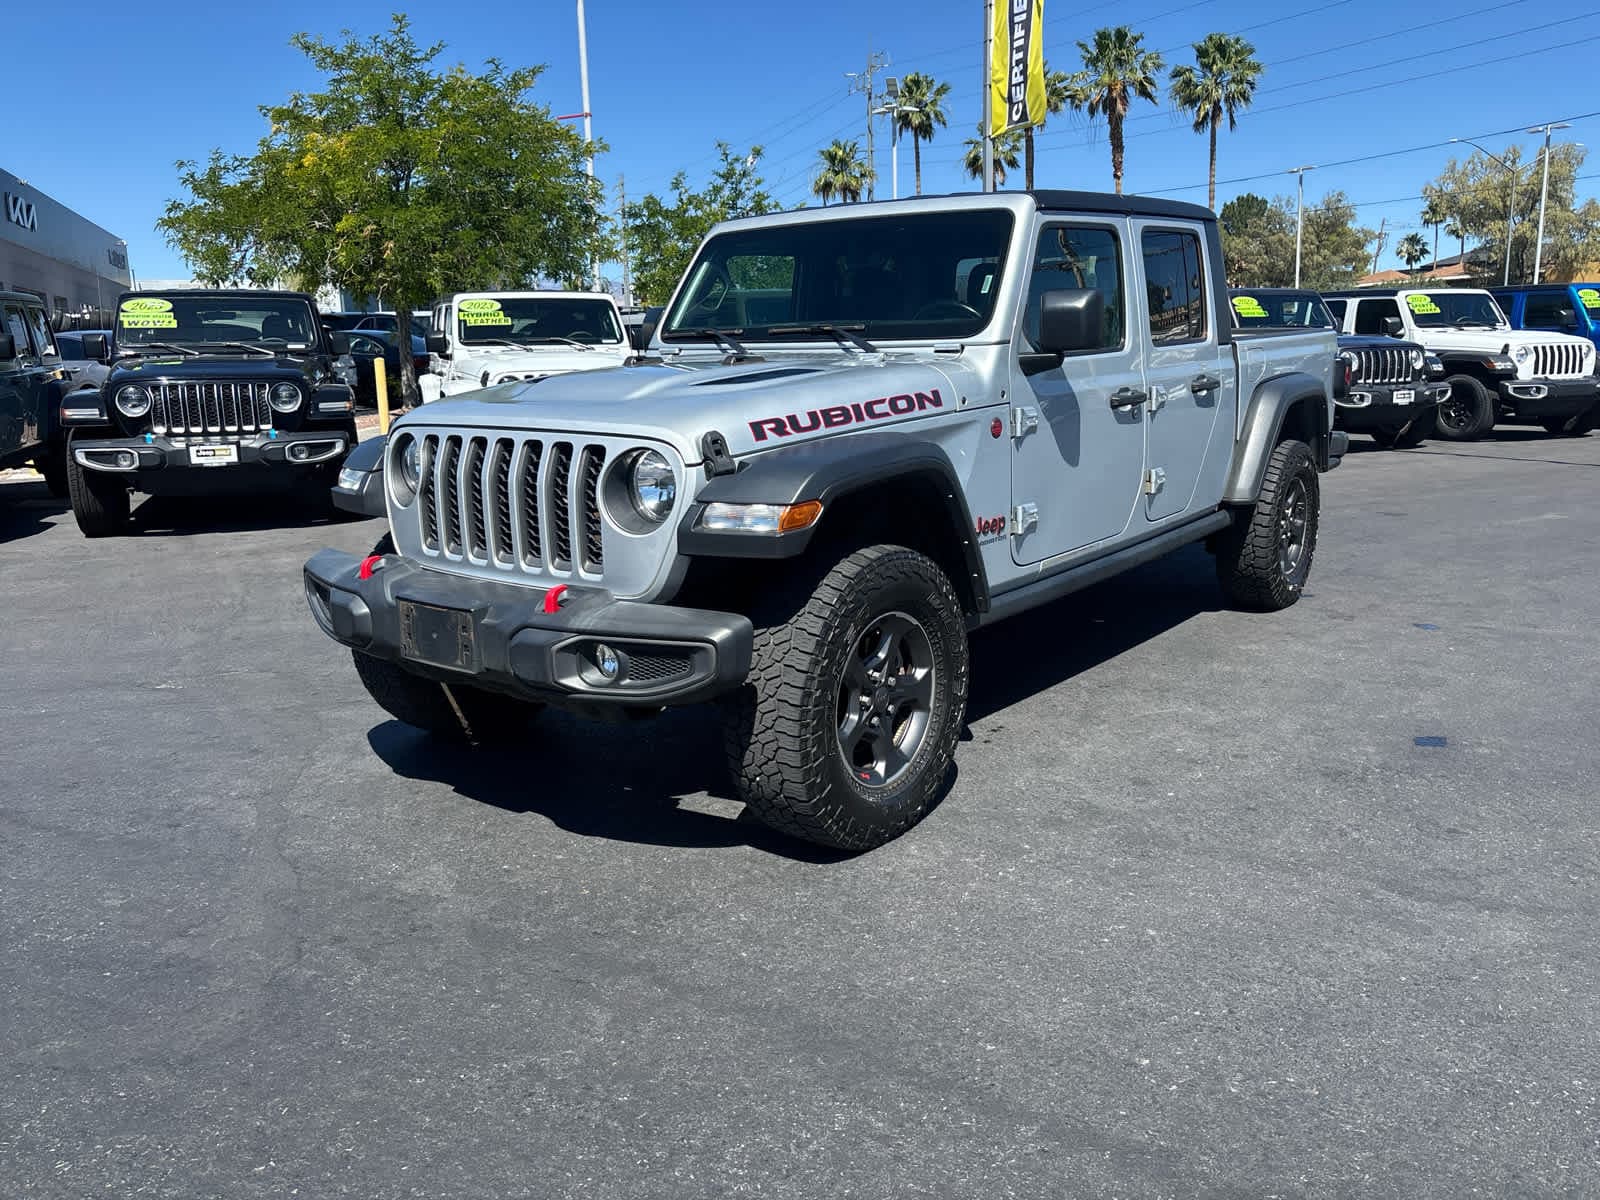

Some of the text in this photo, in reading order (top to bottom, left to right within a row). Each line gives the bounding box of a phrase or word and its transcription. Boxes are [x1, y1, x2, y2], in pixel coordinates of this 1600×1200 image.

[4, 191, 38, 232] KIA
[749, 389, 944, 442] RUBICON
[975, 515, 1006, 536] Jeep
